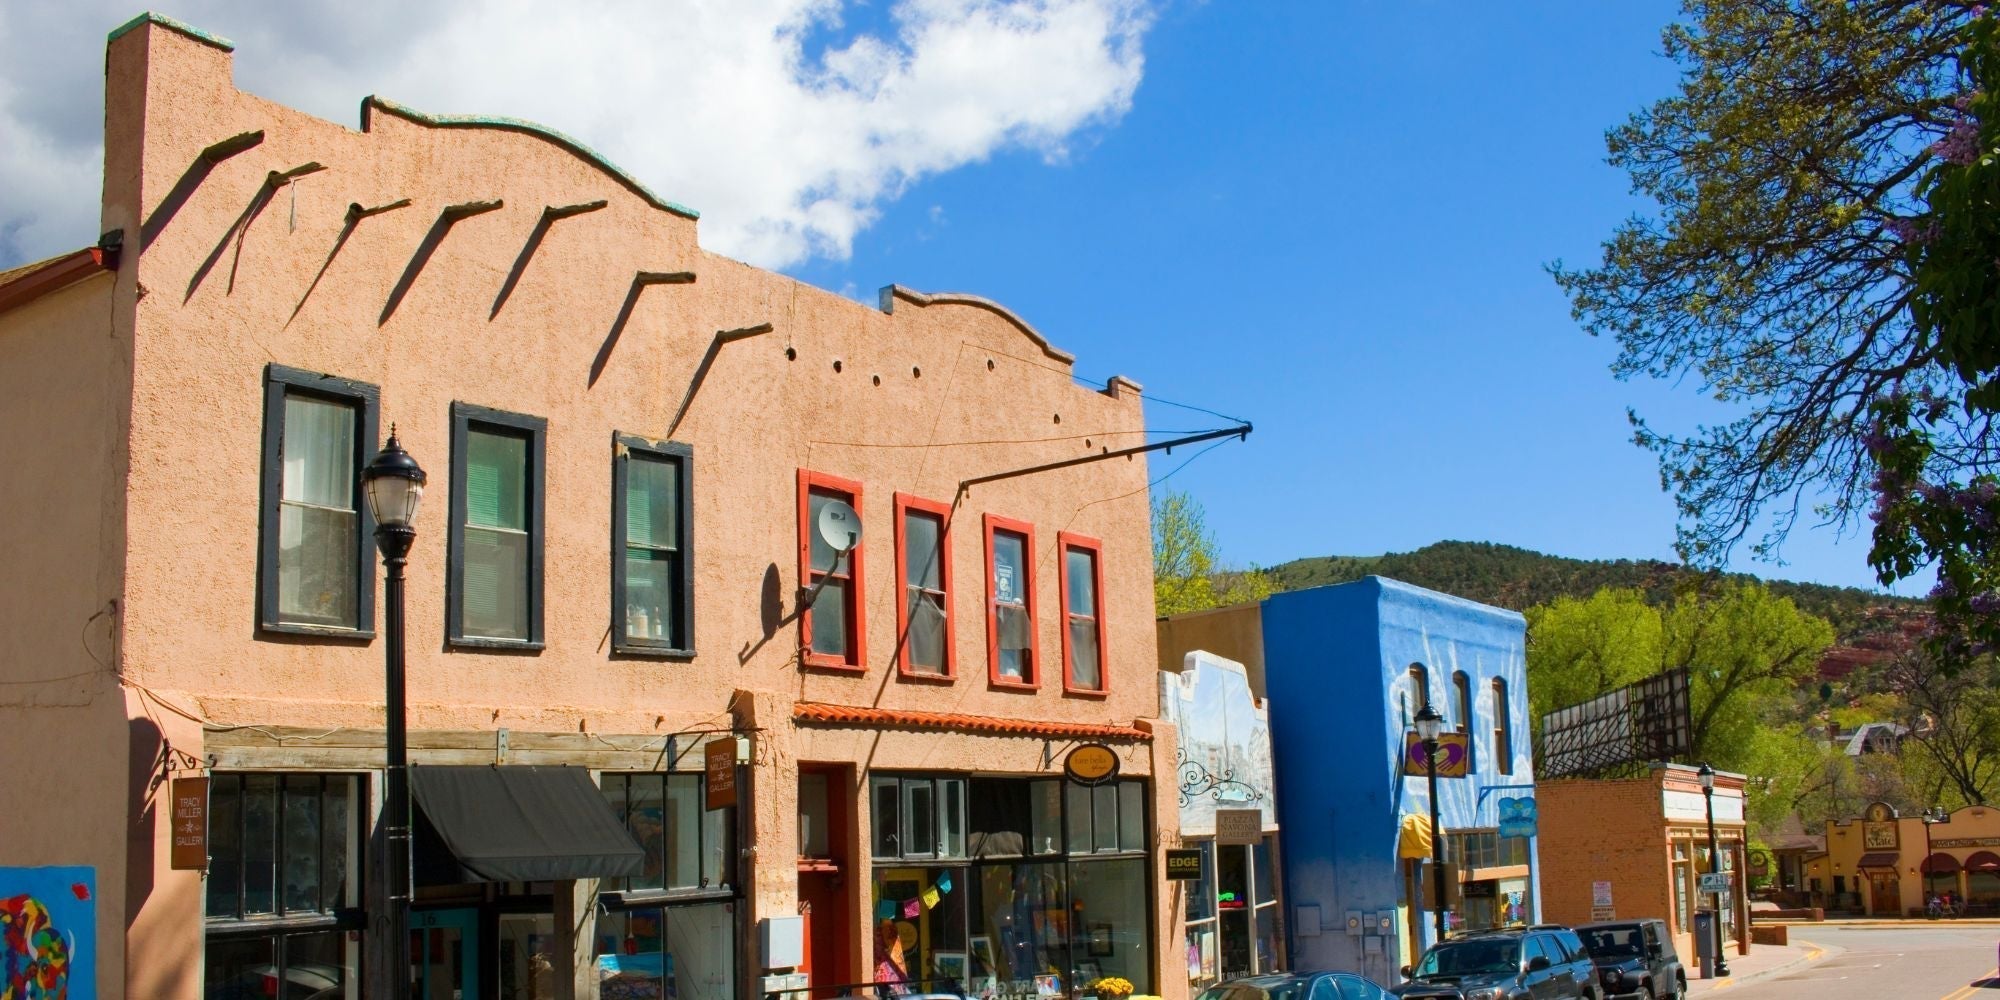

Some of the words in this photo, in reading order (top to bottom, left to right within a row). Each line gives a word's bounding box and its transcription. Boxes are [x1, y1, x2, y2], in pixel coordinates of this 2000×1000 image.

[711, 752, 730, 762] TRACY
[711, 760, 731, 770] MILLER
[710, 780, 734, 792] GALLERY
[180, 797, 200, 807] TRACY
[178, 808, 201, 818] MILLER
[1223, 816, 1254, 824] PIAZZA
[1220, 823, 1257, 832] NAVONA
[1222, 831, 1254, 839] GALLERY
[176, 836, 203, 846] GALLERY
[1169, 857, 1199, 868] EDGE
